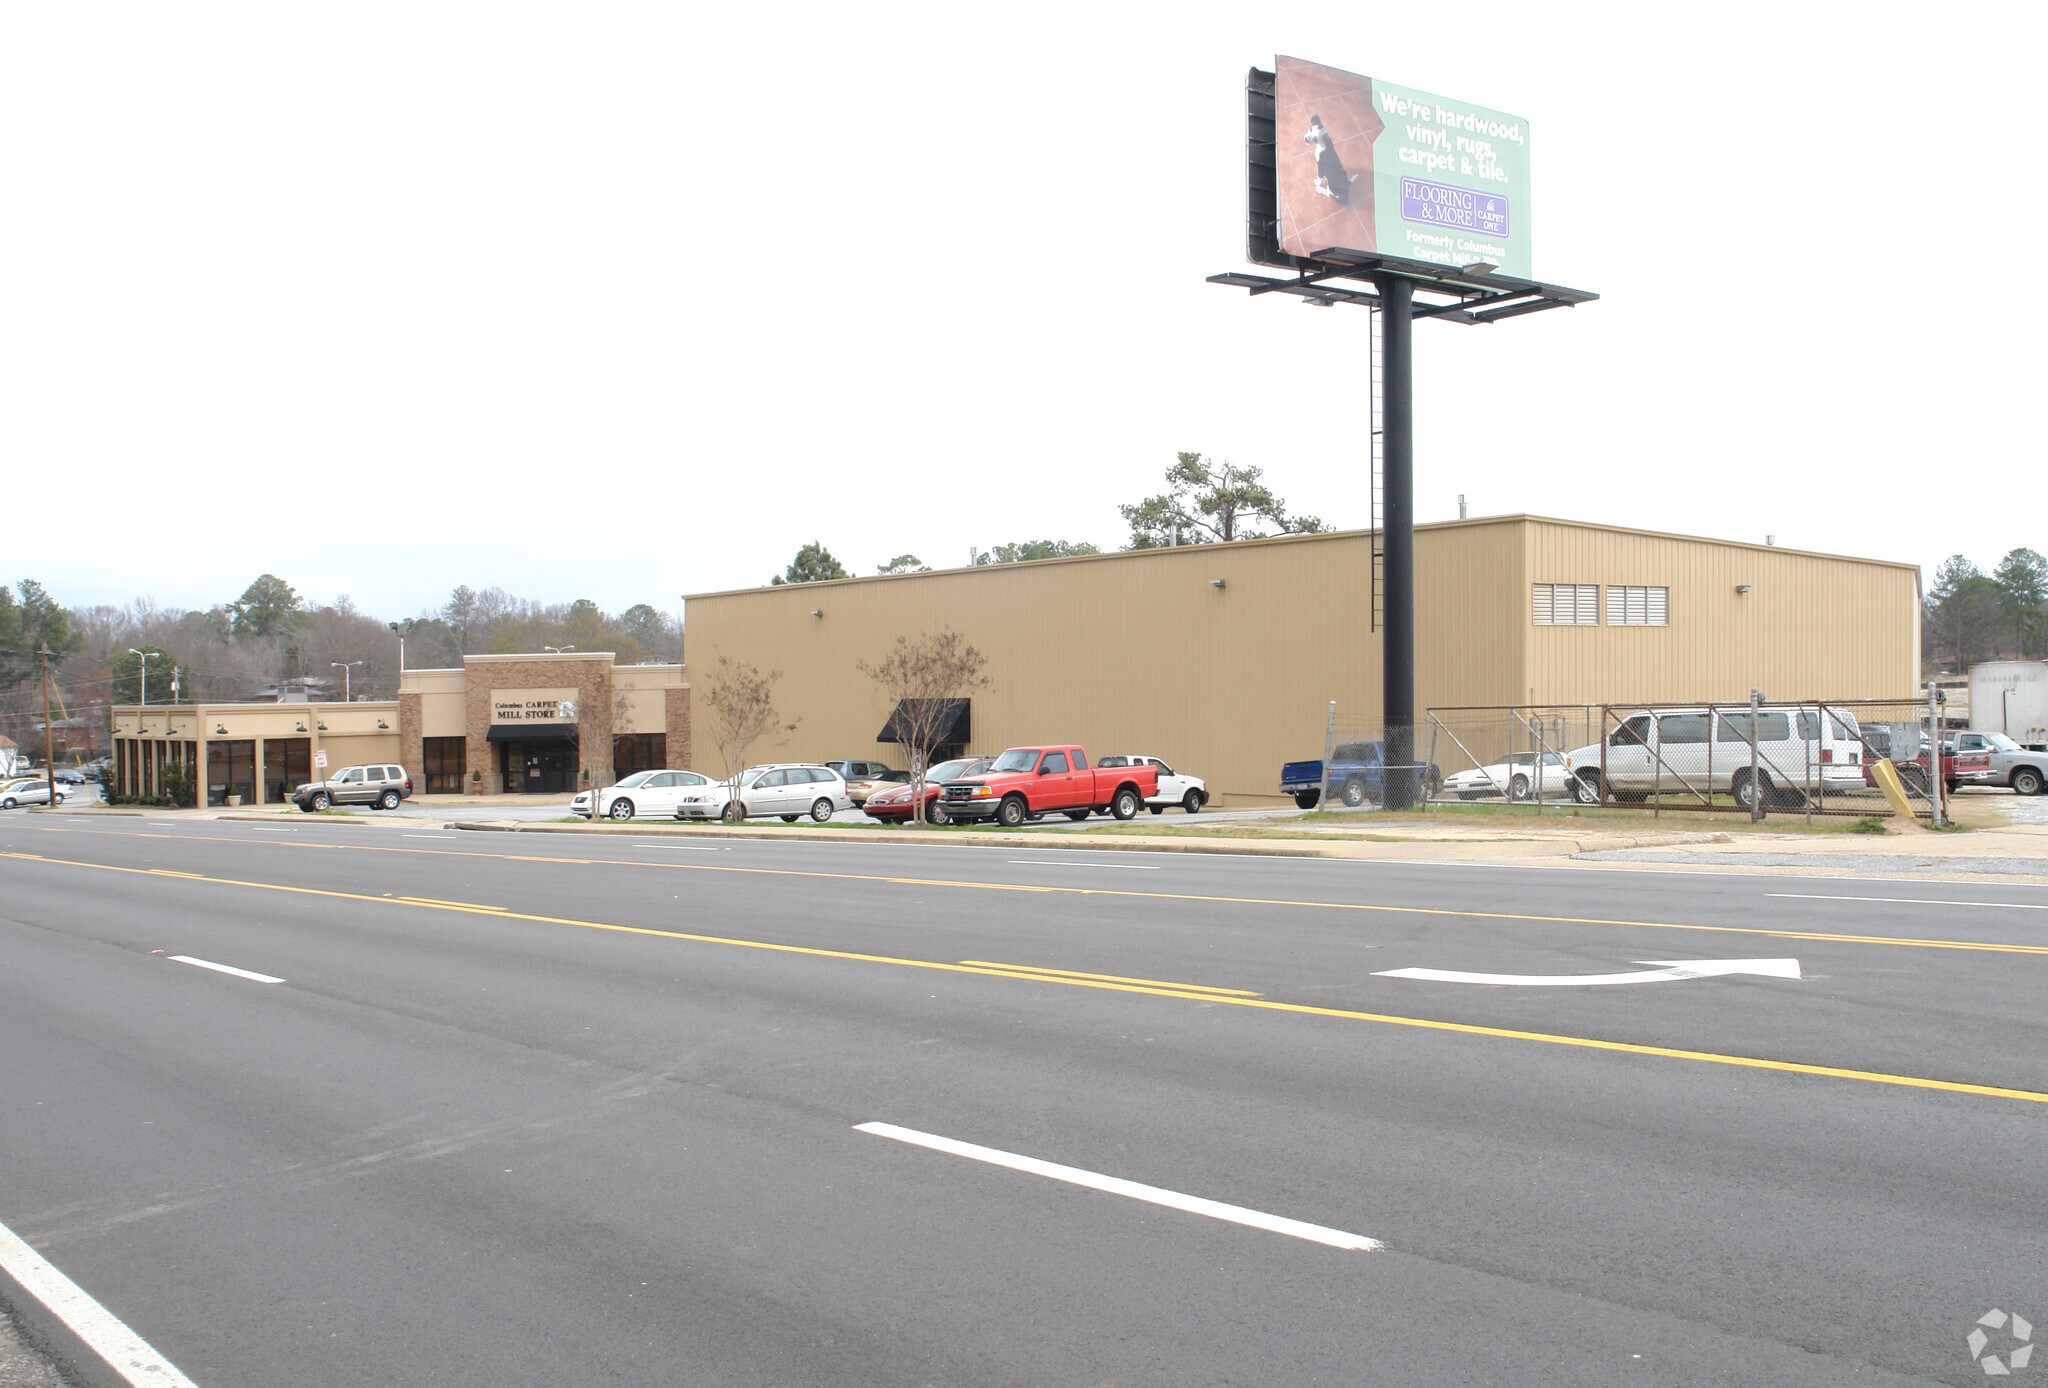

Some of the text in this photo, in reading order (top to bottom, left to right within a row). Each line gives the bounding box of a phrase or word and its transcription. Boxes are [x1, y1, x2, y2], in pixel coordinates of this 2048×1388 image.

[1380, 91, 1524, 146] We're hardwood,
[1405, 123, 1497, 162] vinyl, rugs,
[1398, 147, 1509, 183] carpet & tile.
[1404, 181, 1473, 210] FLOORING
[1421, 202, 1473, 226] & MORE
[1477, 210, 1505, 224] CARPET
[1483, 219, 1499, 232] ONE
[1405, 229, 1506, 257] Formerly Columbus
[1413, 245, 1451, 263] Carpet
[498, 710, 555, 719] MILL STORE
